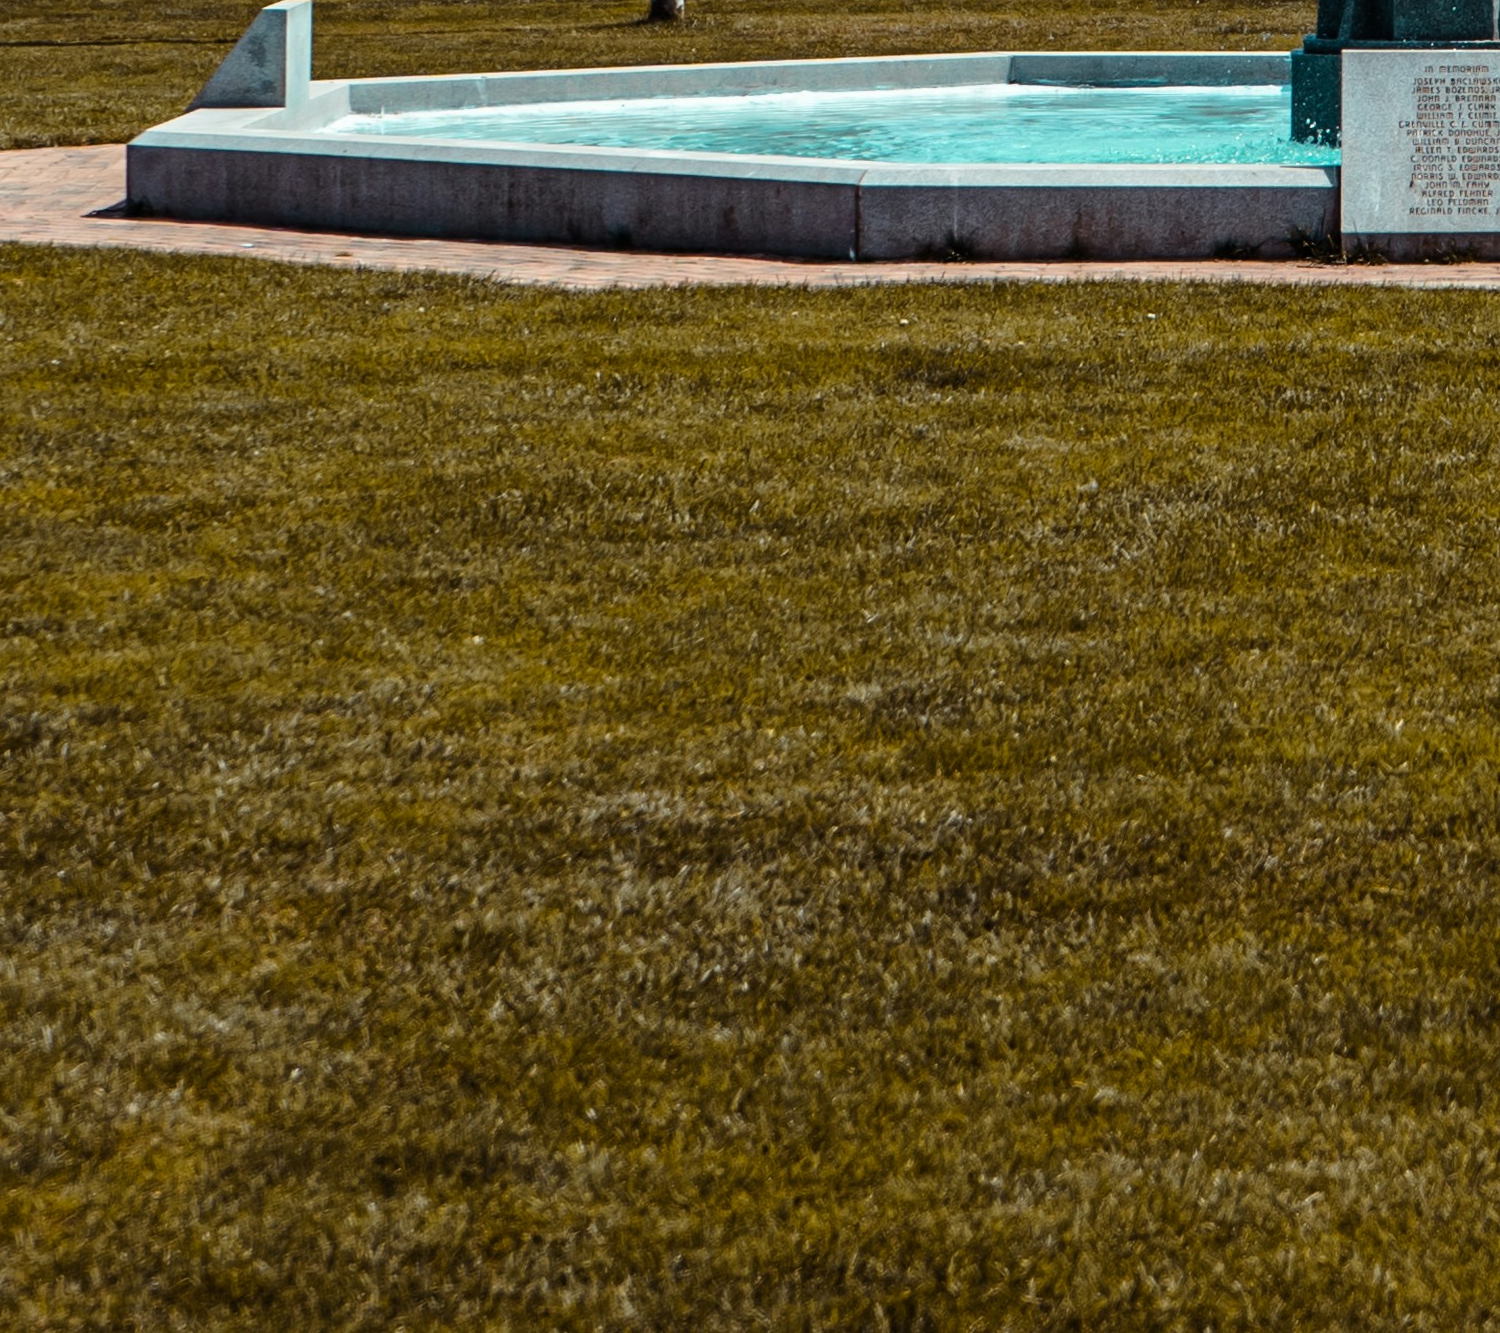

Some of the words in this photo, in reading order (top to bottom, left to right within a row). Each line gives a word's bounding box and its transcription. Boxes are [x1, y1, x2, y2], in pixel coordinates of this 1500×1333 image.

[1422, 155, 1457, 163] DONALD
[1412, 172, 1444, 180] NORRIS
[1410, 207, 1453, 215] REGINALD
